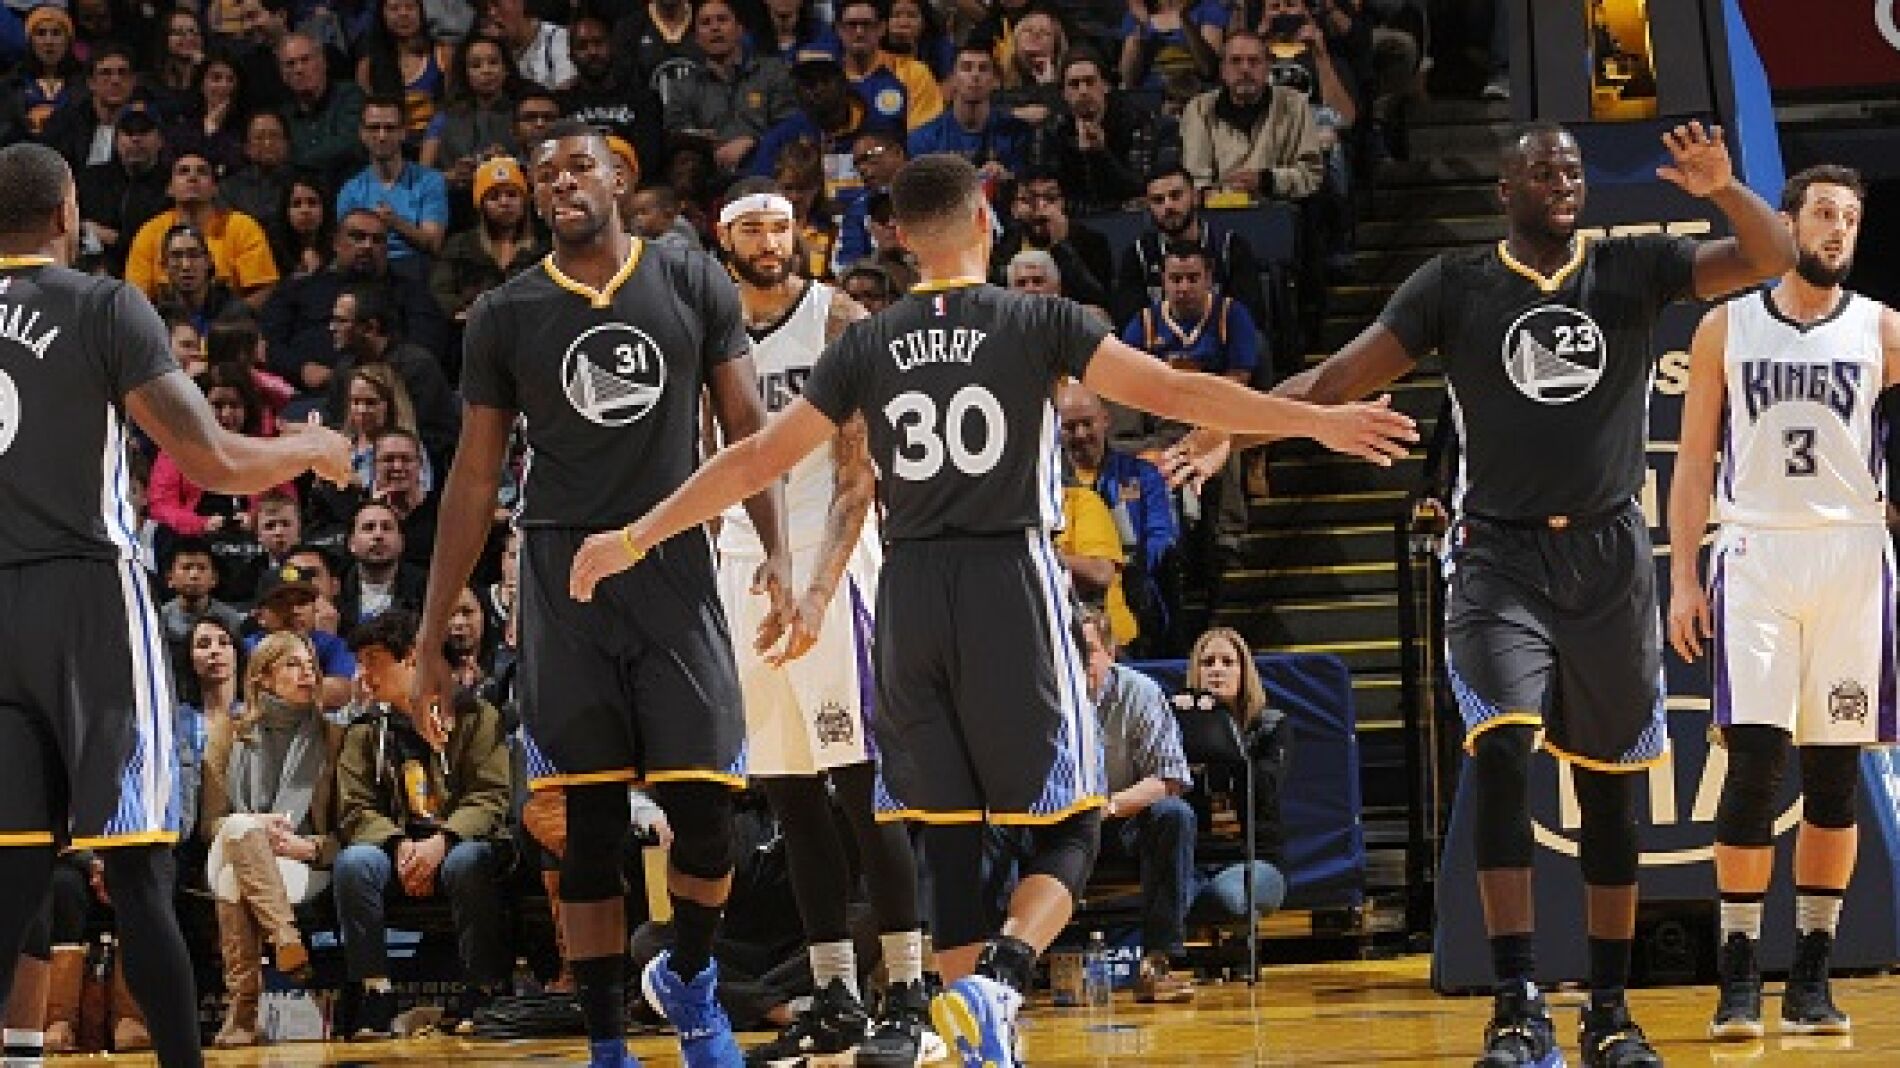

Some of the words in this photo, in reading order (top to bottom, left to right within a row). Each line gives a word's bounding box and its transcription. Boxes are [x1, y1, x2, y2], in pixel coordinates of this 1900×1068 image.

[613, 342, 649, 373] 31
[889, 330, 987, 372] CURRY
[1554, 326, 1596, 352] 23
[1742, 358, 1861, 426] KINGS
[882, 384, 1008, 480] 30
[1782, 427, 1818, 477] 3
